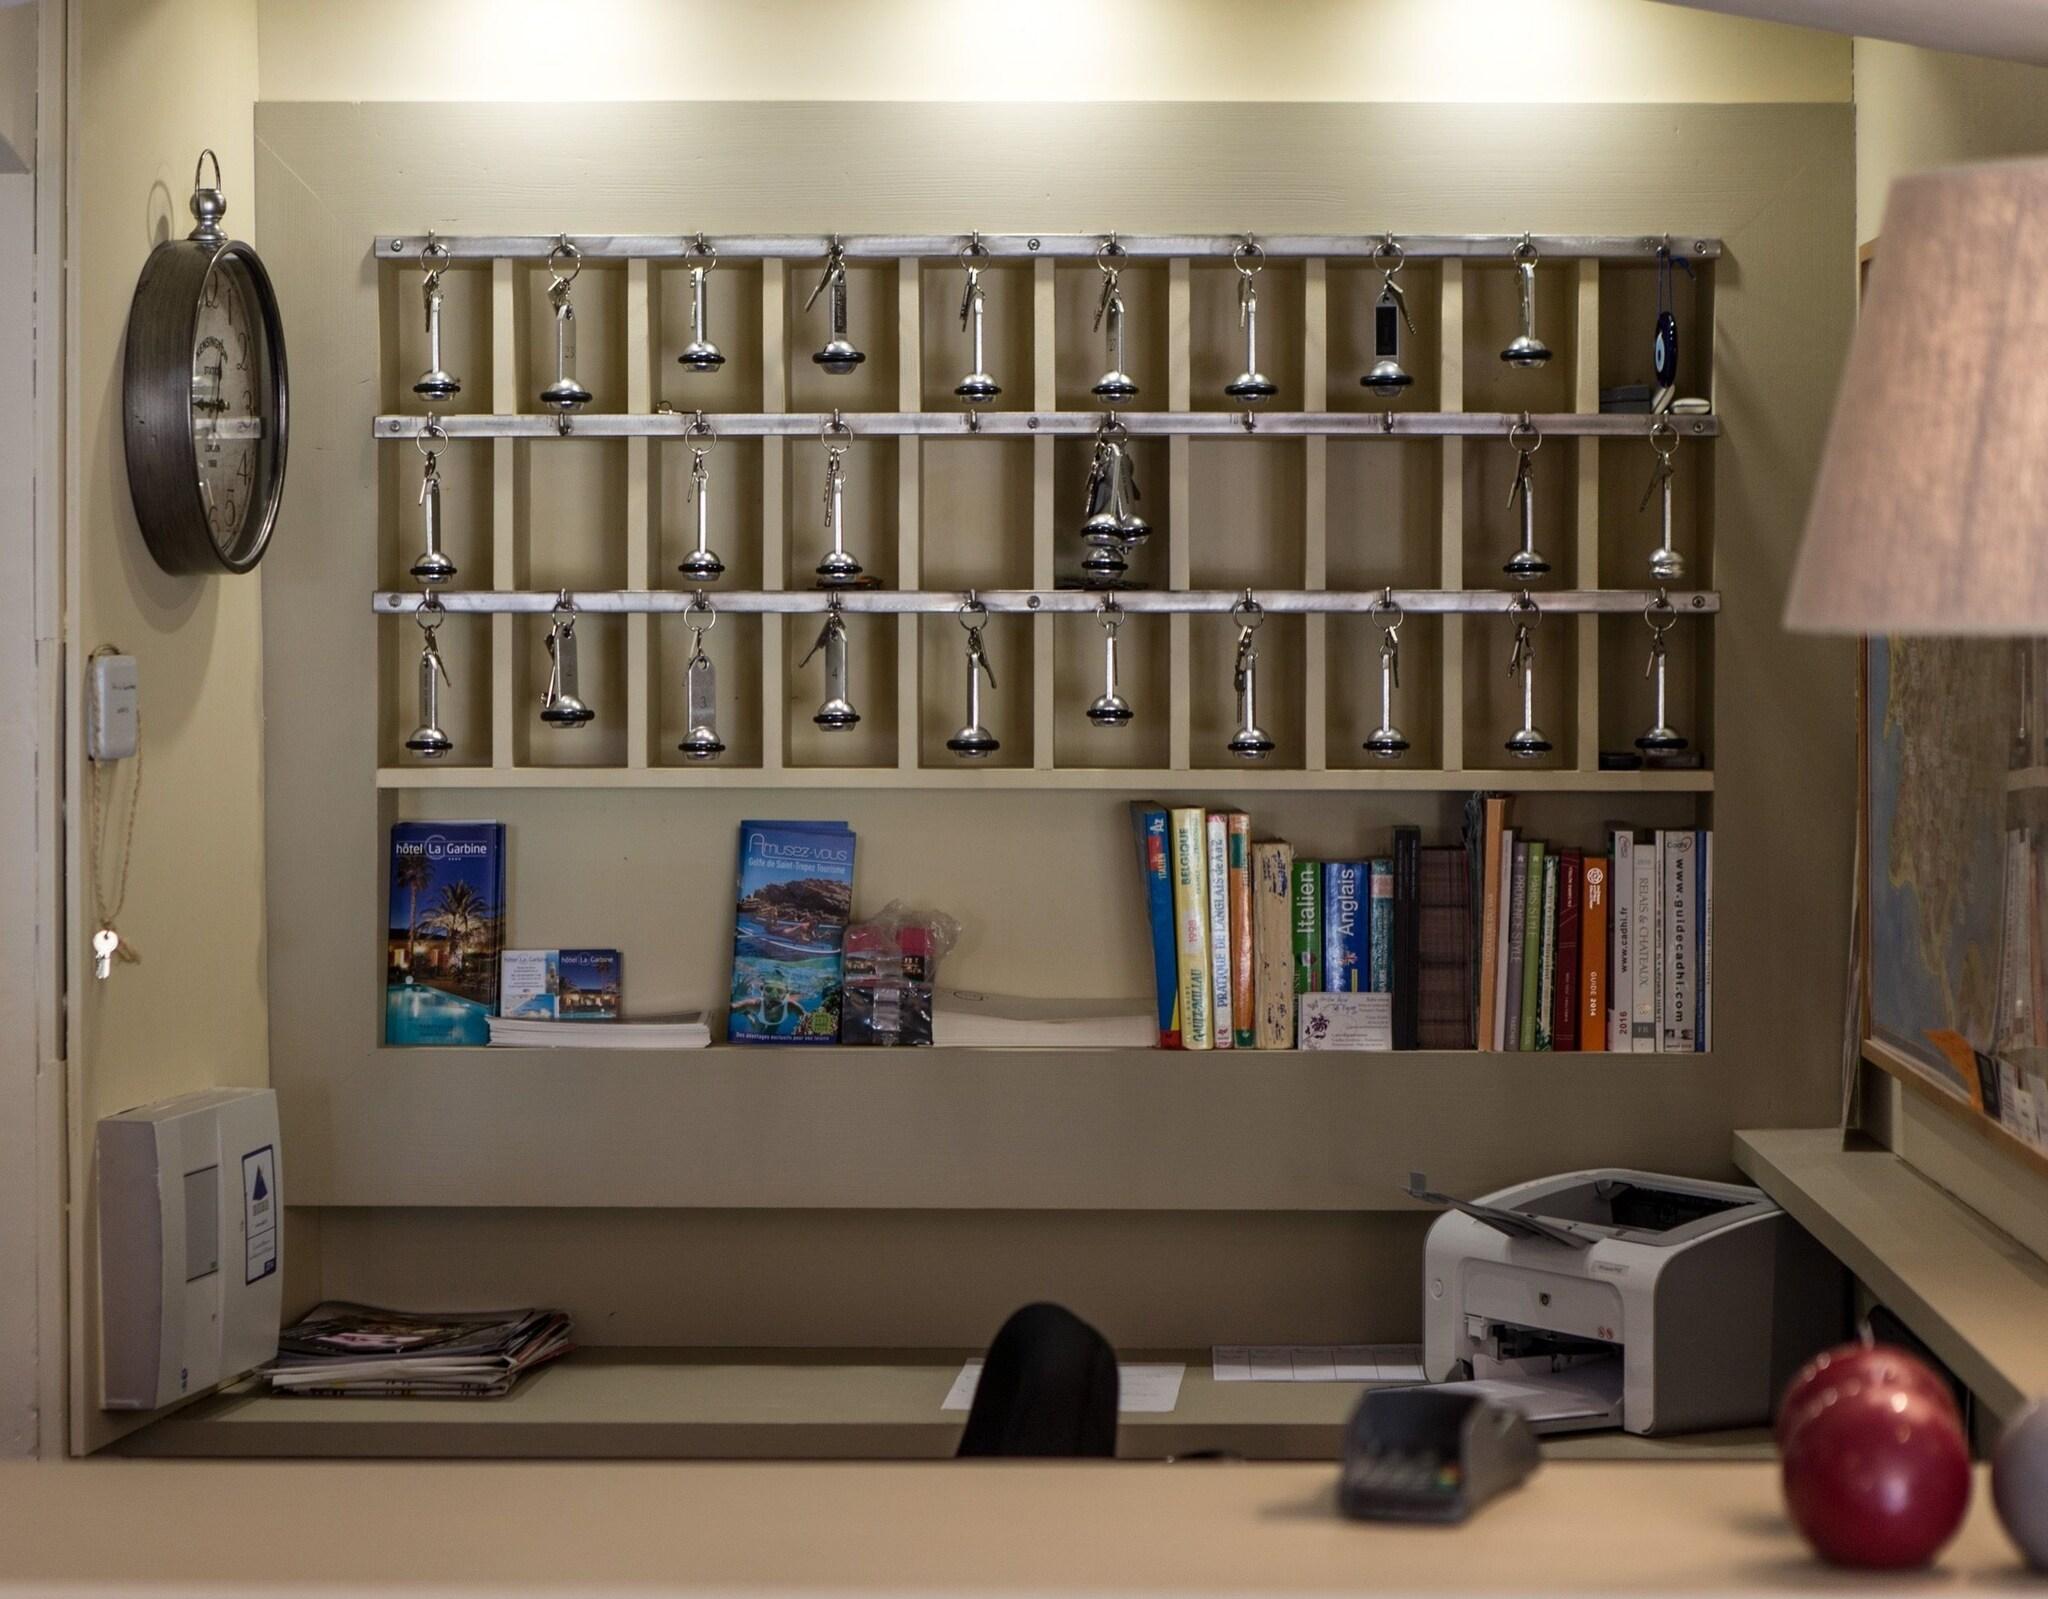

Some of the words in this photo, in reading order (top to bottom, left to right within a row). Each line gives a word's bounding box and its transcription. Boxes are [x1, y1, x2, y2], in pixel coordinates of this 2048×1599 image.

[236, 332, 248, 371] 2
[236, 449, 249, 486] 4
[396, 843, 423, 854] hôtel
[428, 843, 441, 854] La
[446, 843, 487, 854] Garbine
[1179, 828, 1191, 885] BELGIQUE
[1296, 869, 1315, 933] Italien
[1337, 868, 1358, 937] Anglais
[1512, 874, 1526, 930] PROVENCE
[1639, 877, 1649, 913] RELAIS
[1527, 907, 1538, 937] STYLE
[1620, 906, 1629, 974] www.cadhi.fr
[1674, 858, 1686, 1022] www.guidecadhi.com
[1215, 935, 1226, 950] DE
[1510, 931, 1522, 963] STYLE
[1215, 954, 1229, 1008] PRATIQUE
[1590, 971, 1598, 995] GUIDE
